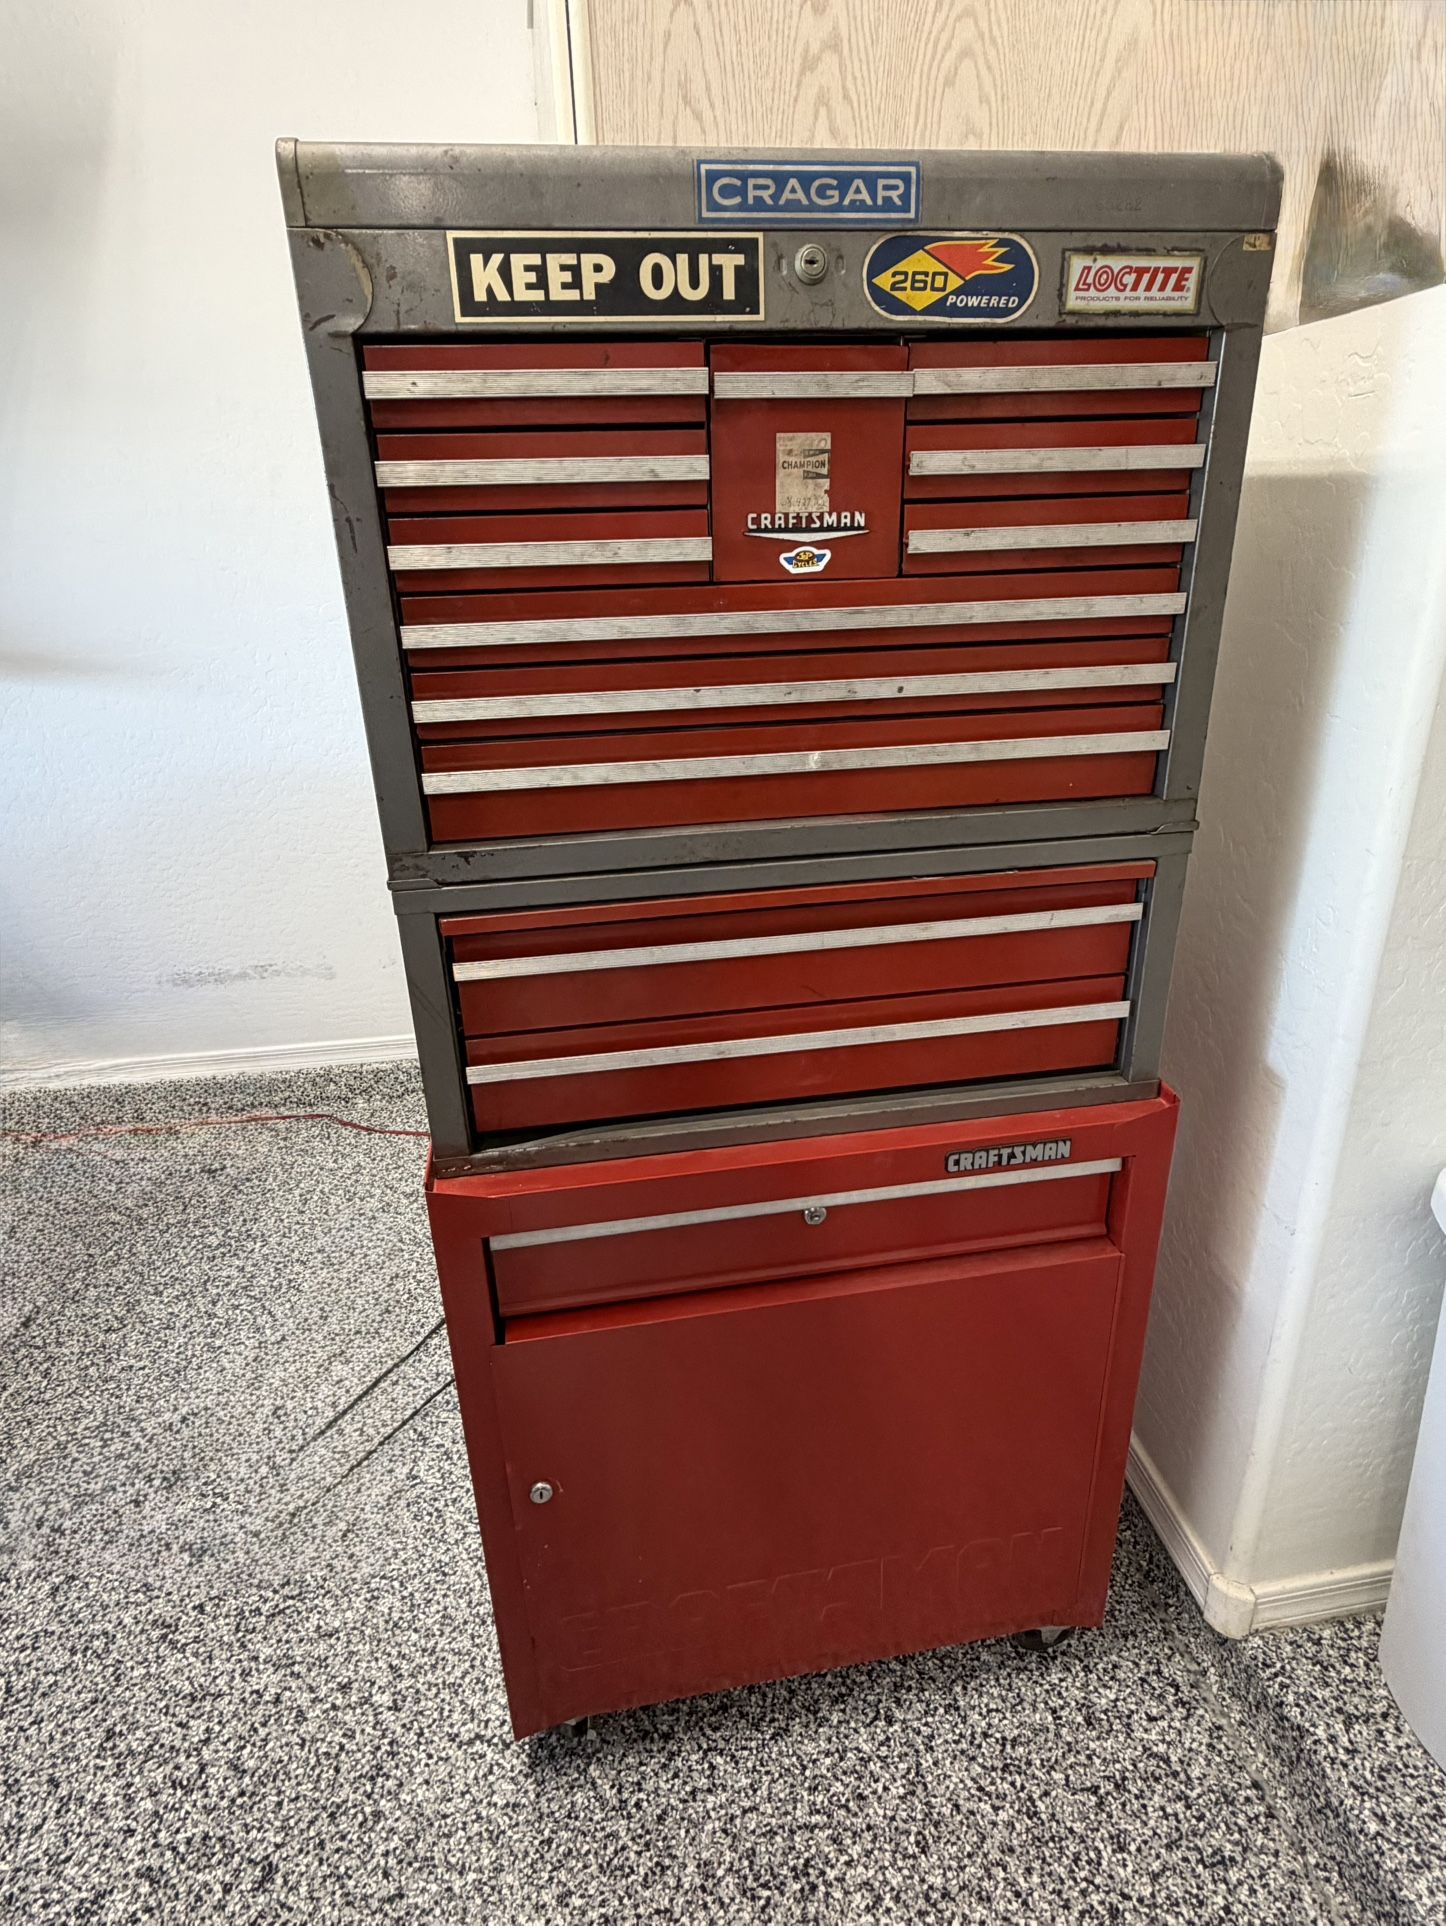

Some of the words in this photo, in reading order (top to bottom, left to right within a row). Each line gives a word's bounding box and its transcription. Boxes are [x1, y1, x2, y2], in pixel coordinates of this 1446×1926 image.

[712, 176, 905, 207] CRAGAR
[469, 253, 616, 302] KEEP
[639, 252, 745, 301] OUT
[890, 270, 949, 292] 260
[1073, 265, 1194, 293] LOCTITE
[946, 295, 1019, 308] POWERED
[781, 459, 826, 471] CHAMPION
[747, 511, 866, 529] CRAFTSMAN
[947, 1140, 1072, 1173] CRAFTSMAN
